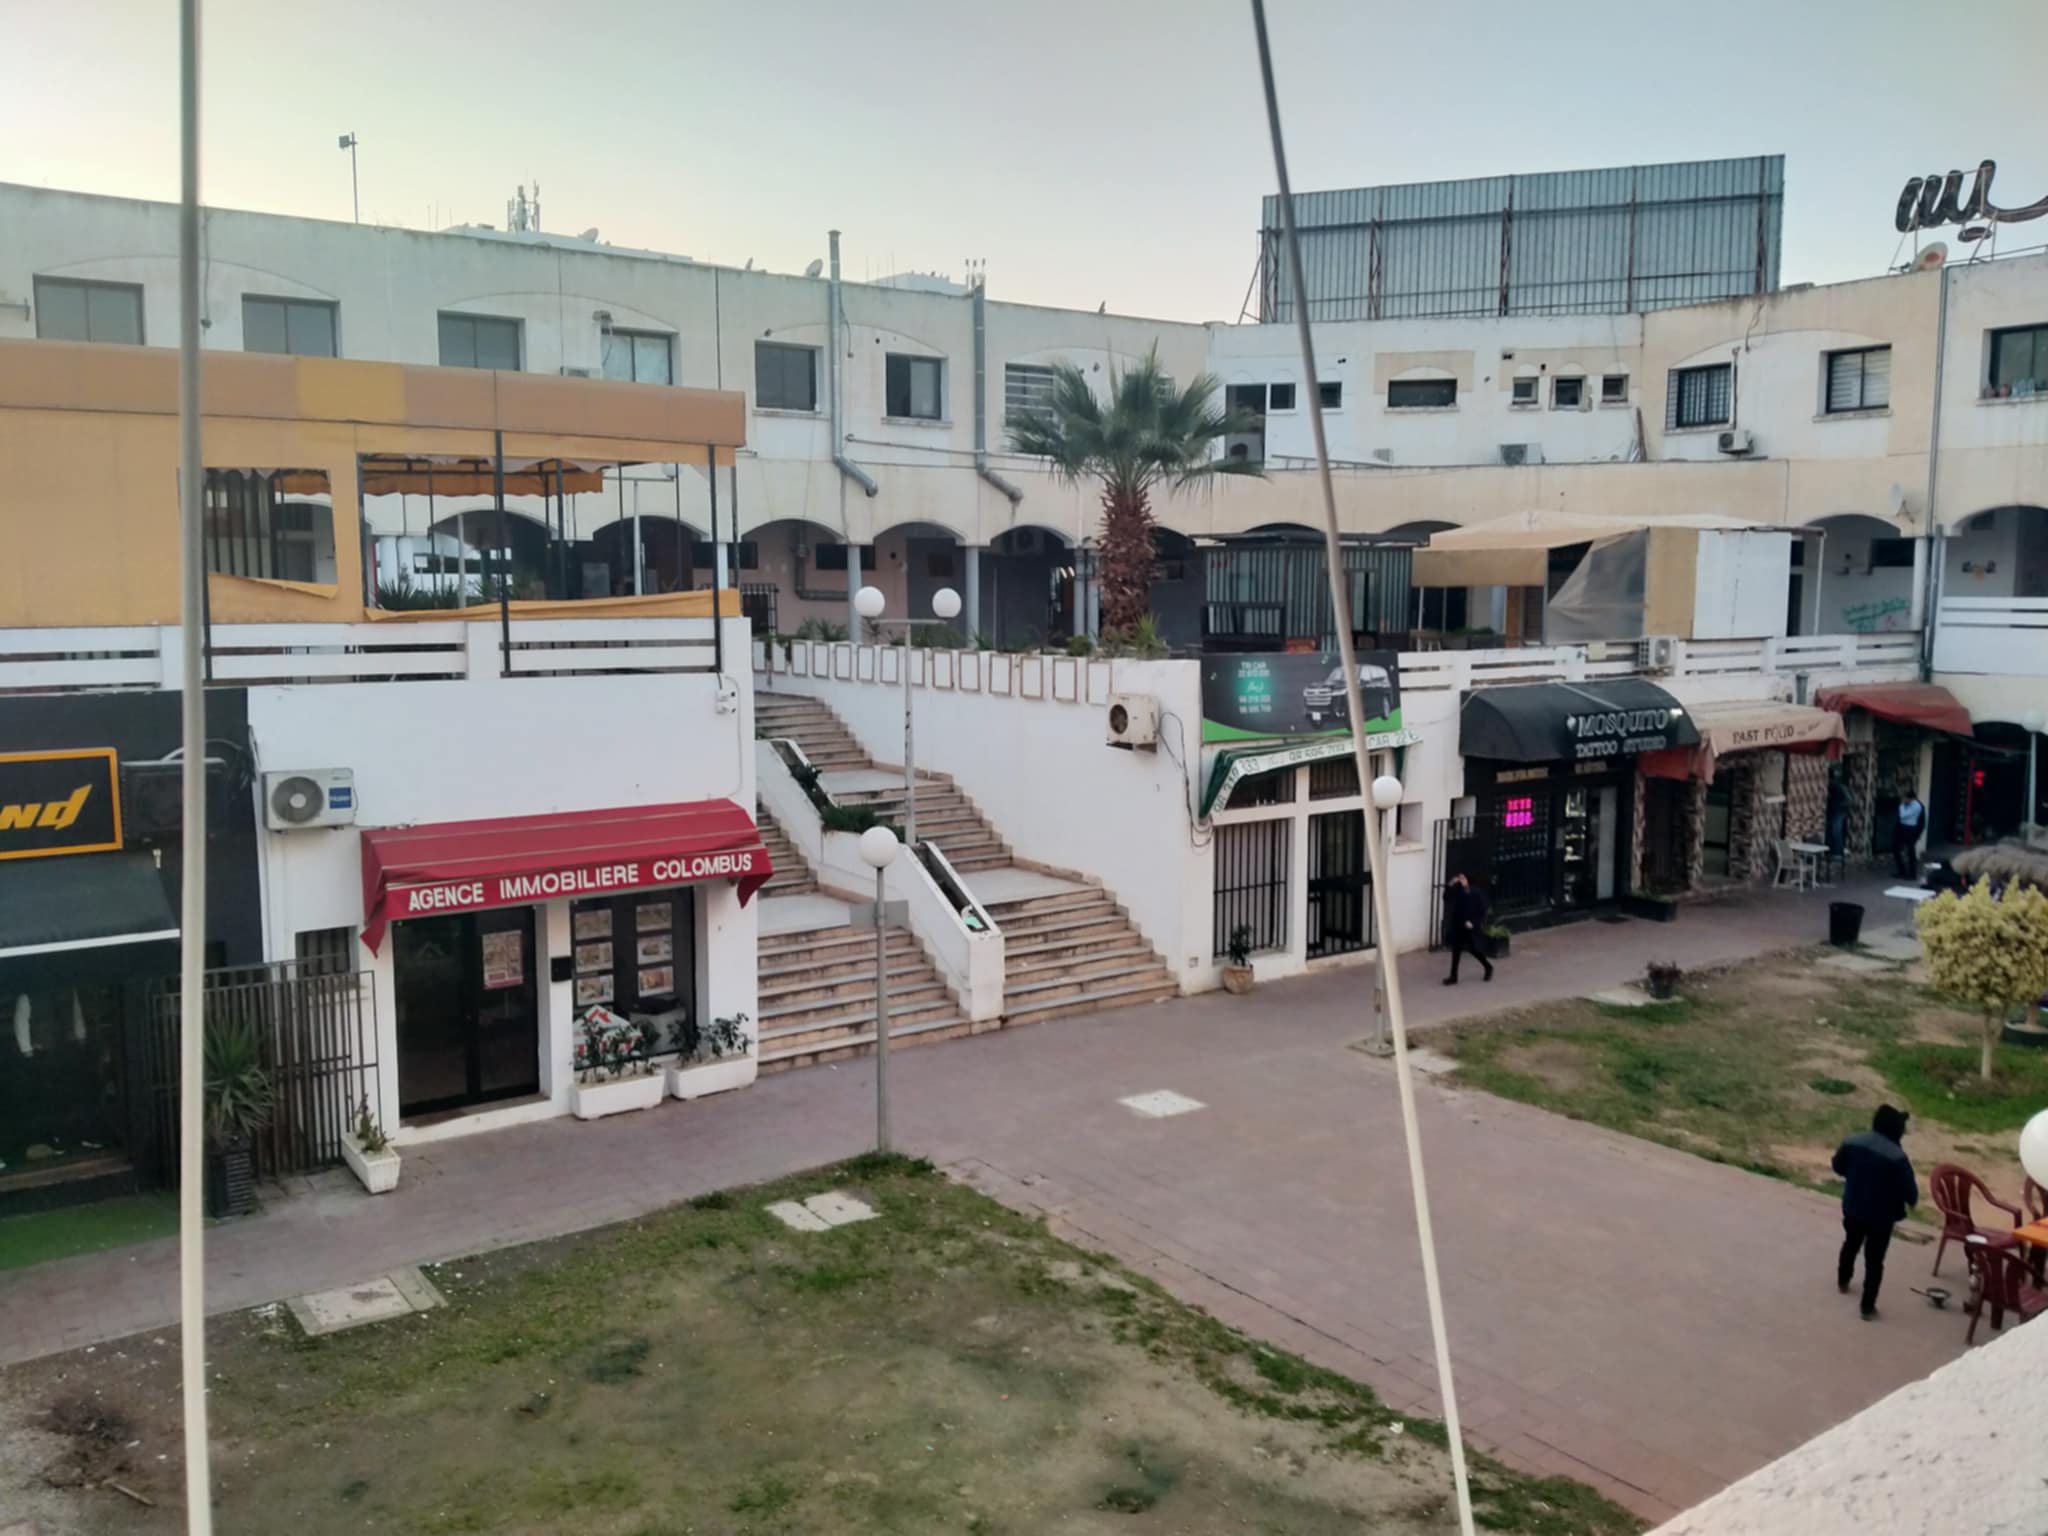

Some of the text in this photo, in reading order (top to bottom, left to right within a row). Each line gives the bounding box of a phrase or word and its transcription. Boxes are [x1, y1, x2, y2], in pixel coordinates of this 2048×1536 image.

[1577, 709, 1668, 737] MOSQUITO
[1732, 729, 1759, 745] FAST
[1575, 740, 1618, 758] TATTOO
[408, 853, 753, 912] AGENCE IMMOBILIERE COLOMBUS
